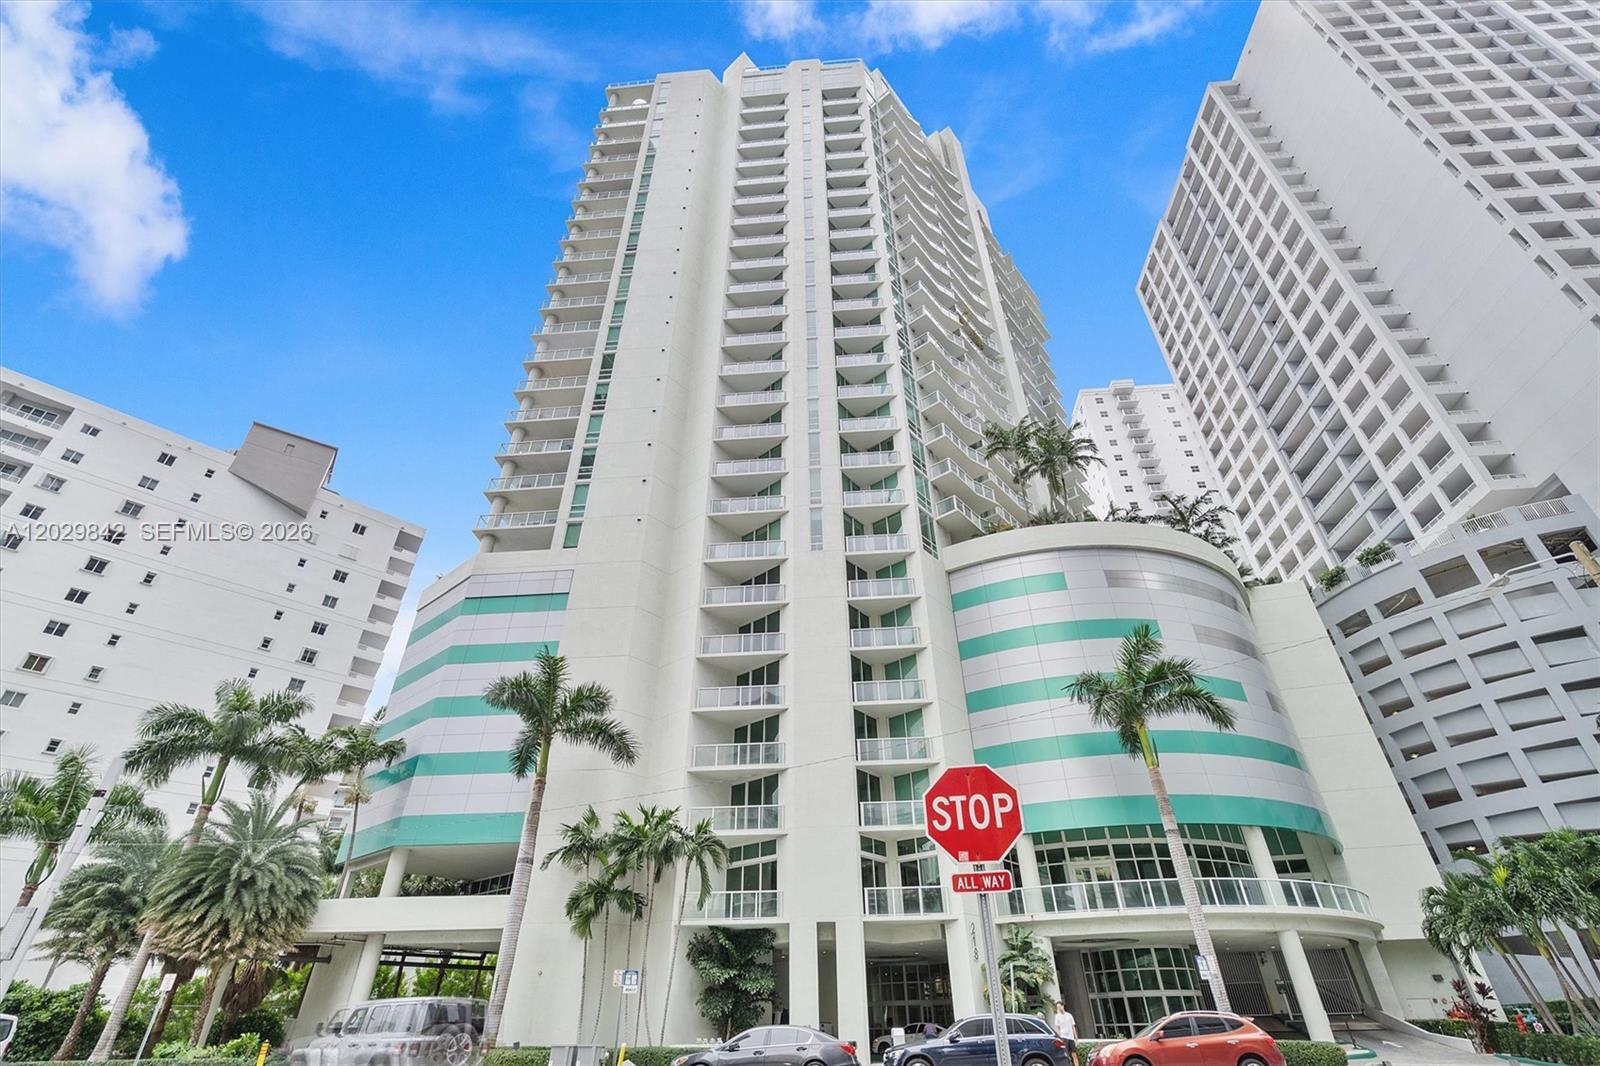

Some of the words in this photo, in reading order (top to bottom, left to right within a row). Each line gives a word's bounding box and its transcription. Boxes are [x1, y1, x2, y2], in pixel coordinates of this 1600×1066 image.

[931, 793, 1014, 832] STOP
[957, 877, 979, 890] ALL
[982, 875, 1006, 888] WAY
